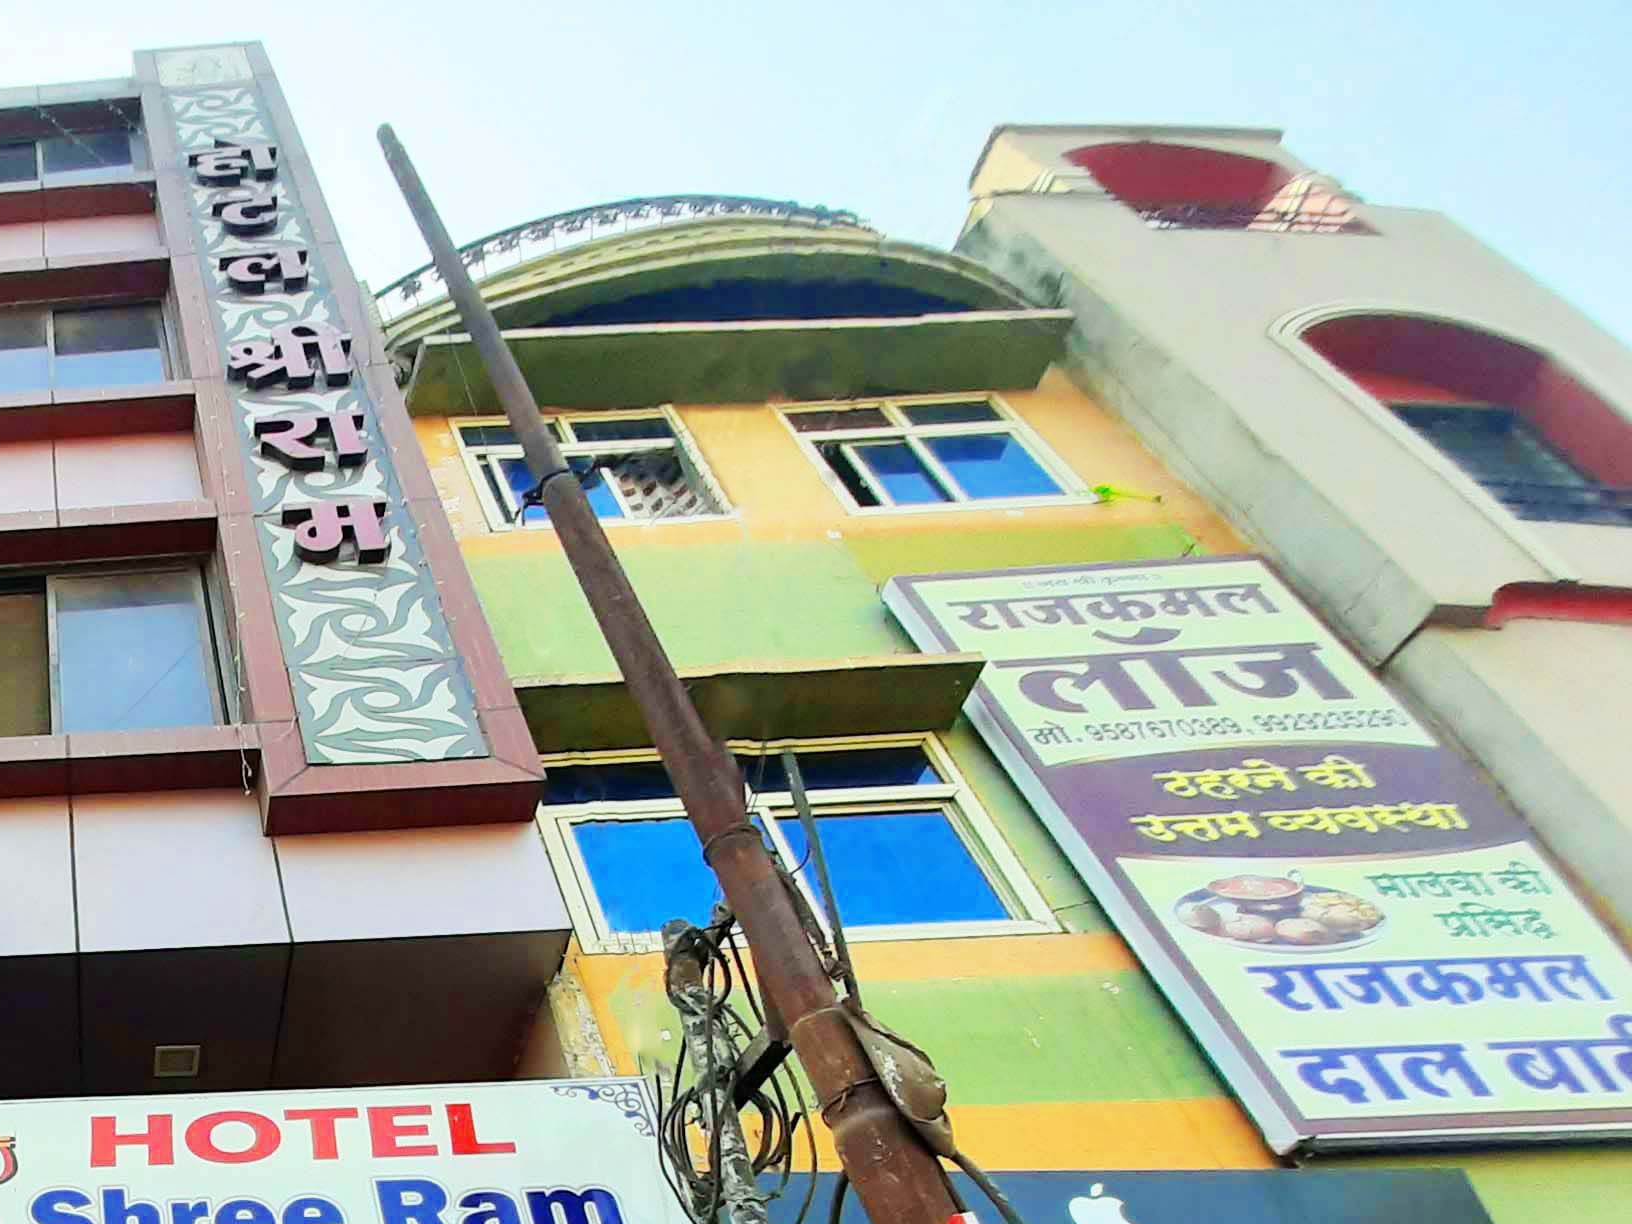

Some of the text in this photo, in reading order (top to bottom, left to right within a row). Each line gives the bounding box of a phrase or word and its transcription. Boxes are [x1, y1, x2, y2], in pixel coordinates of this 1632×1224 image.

[945, 583, 1281, 630] राजकमल
[988, 626, 1356, 714] लॉज
[1152, 754, 1378, 800] ठहरने की
[1128, 801, 1469, 843] उत्तम व्यवस्था
[1491, 860, 1553, 896] की
[1246, 954, 1614, 1013] राजकमल
[1278, 1042, 1494, 1105] दाल
[88, 1102, 517, 1170] HOTEL
